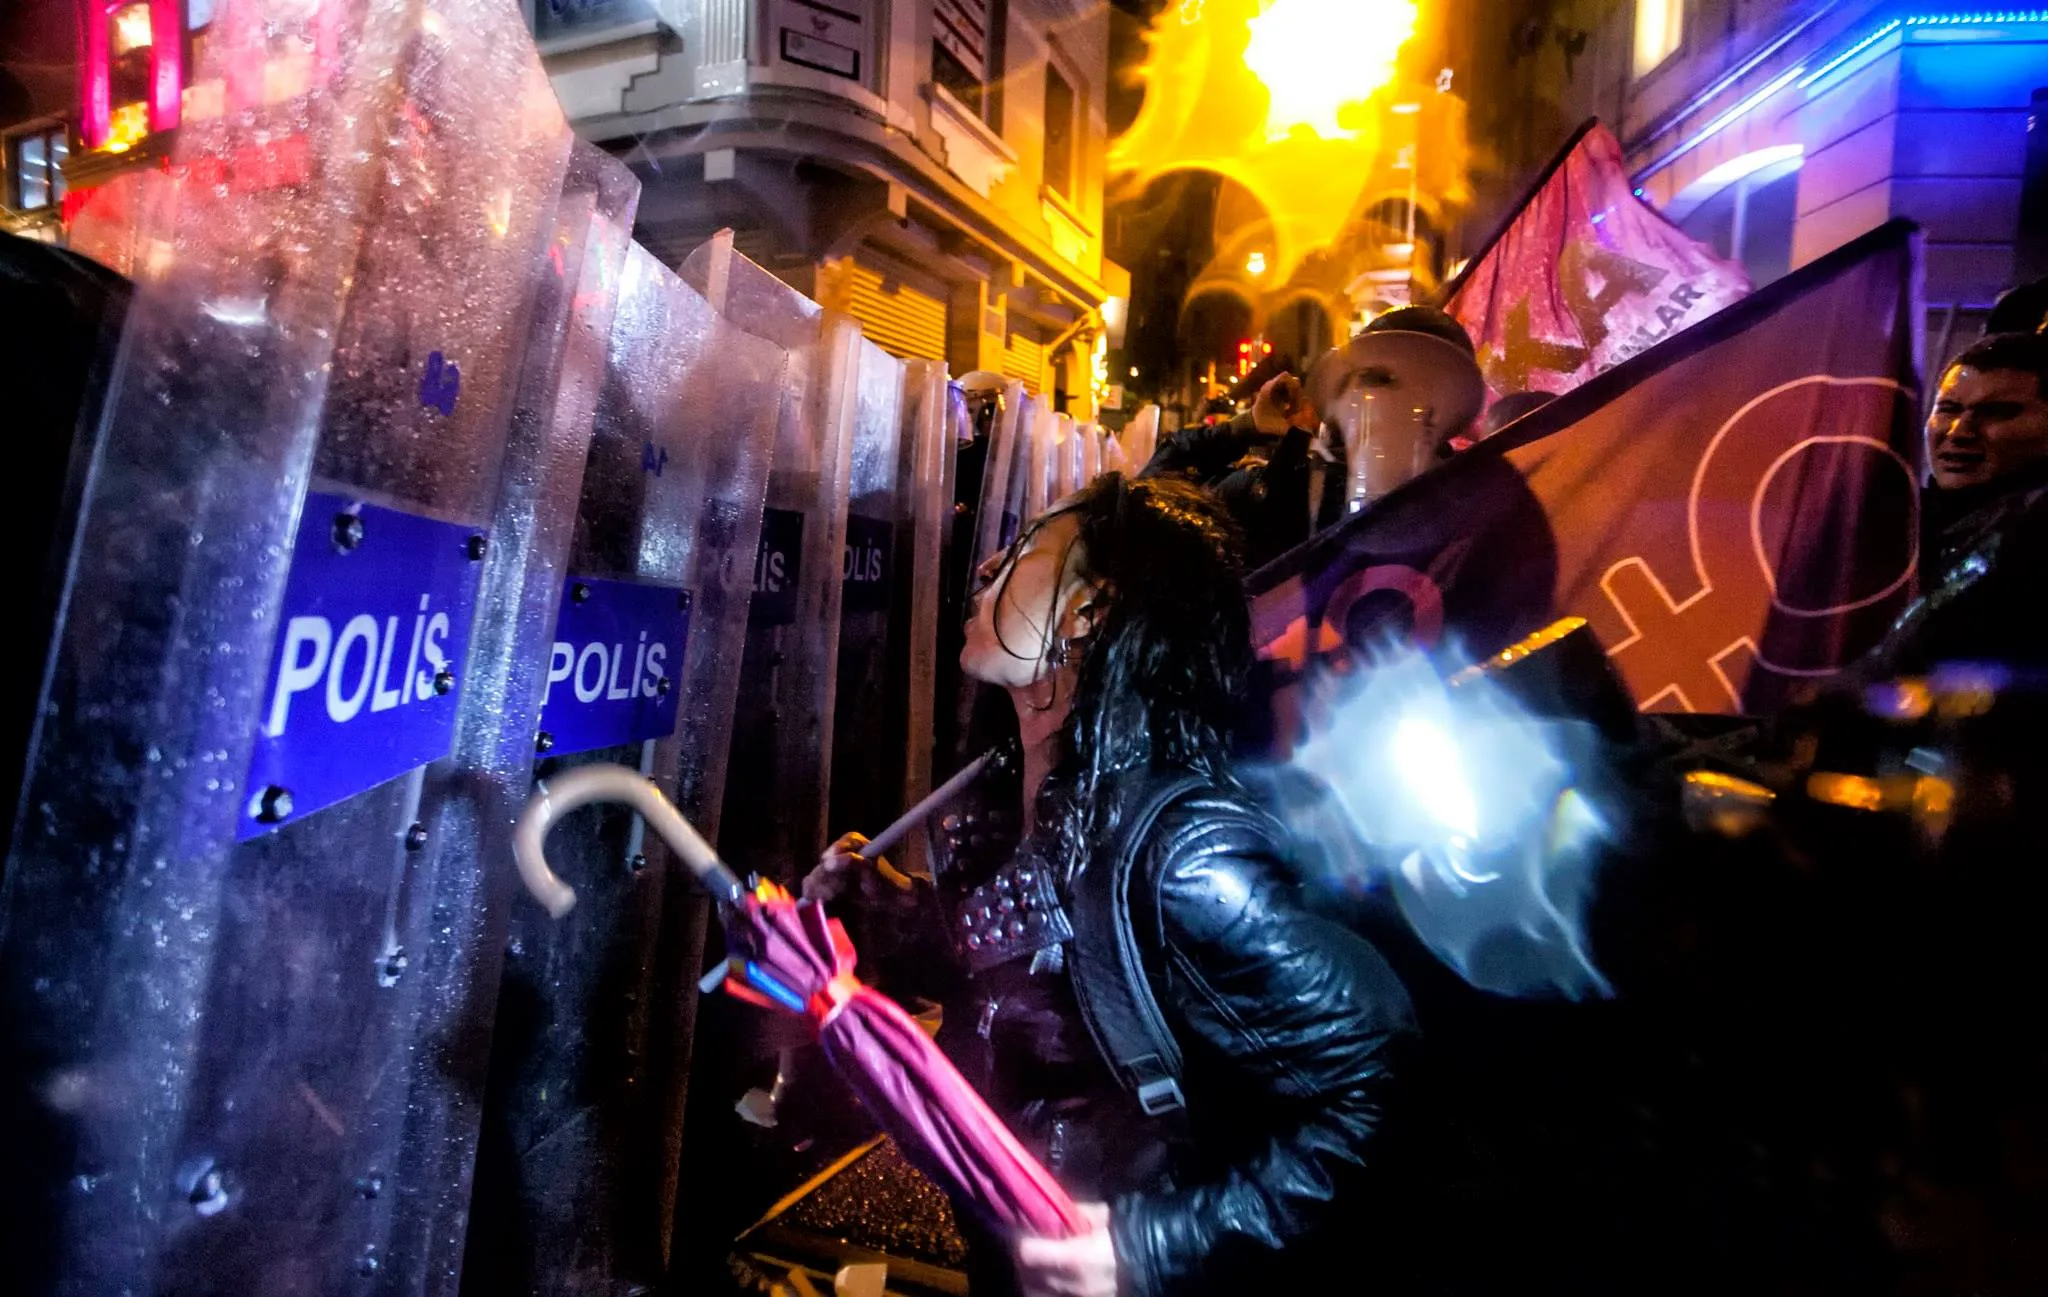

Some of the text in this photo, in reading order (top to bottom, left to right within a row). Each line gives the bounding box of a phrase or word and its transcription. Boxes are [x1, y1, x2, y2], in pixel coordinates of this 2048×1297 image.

[843, 538, 882, 582] OLİS
[267, 593, 450, 738] POLİS
[542, 631, 669, 706] POLİS
